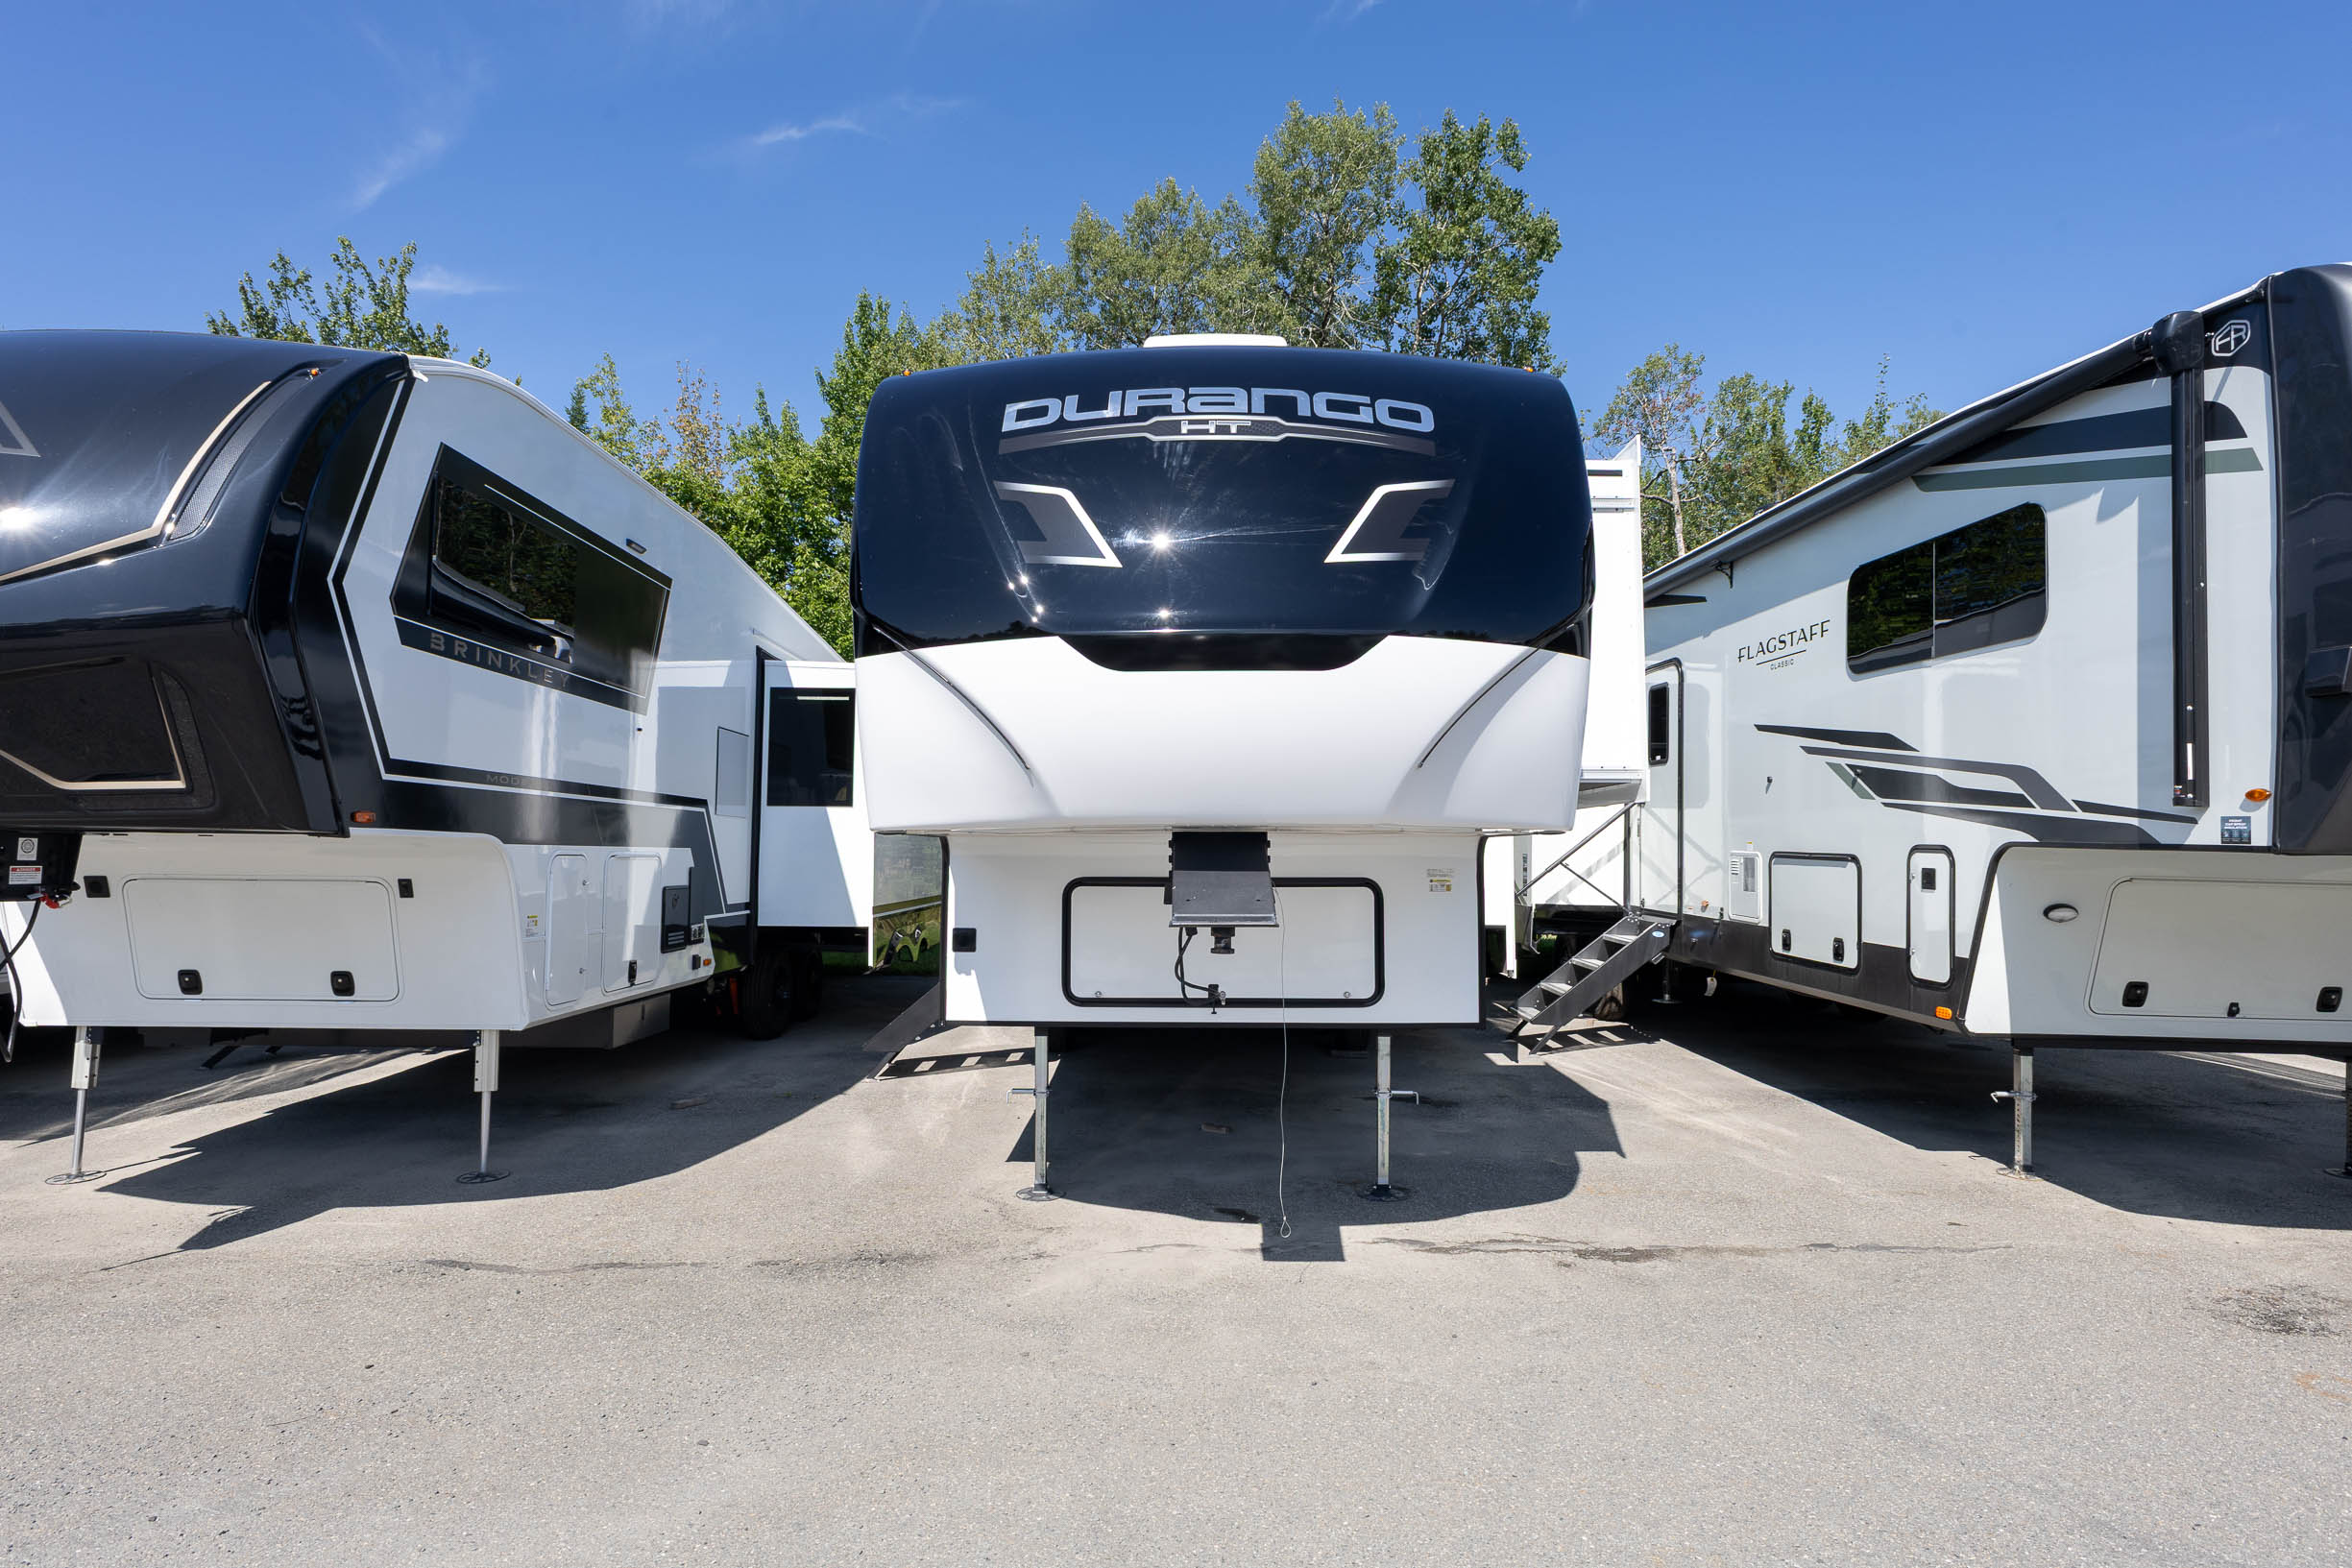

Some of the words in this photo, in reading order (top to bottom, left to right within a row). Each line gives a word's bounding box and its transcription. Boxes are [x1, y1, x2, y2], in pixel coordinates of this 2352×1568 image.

[1180, 420, 1252, 434] HT
[1737, 619, 1831, 663] FLAGSTAFF
[429, 633, 570, 688] BRINKLEY
[1770, 659, 1794, 670] CLASSIC
